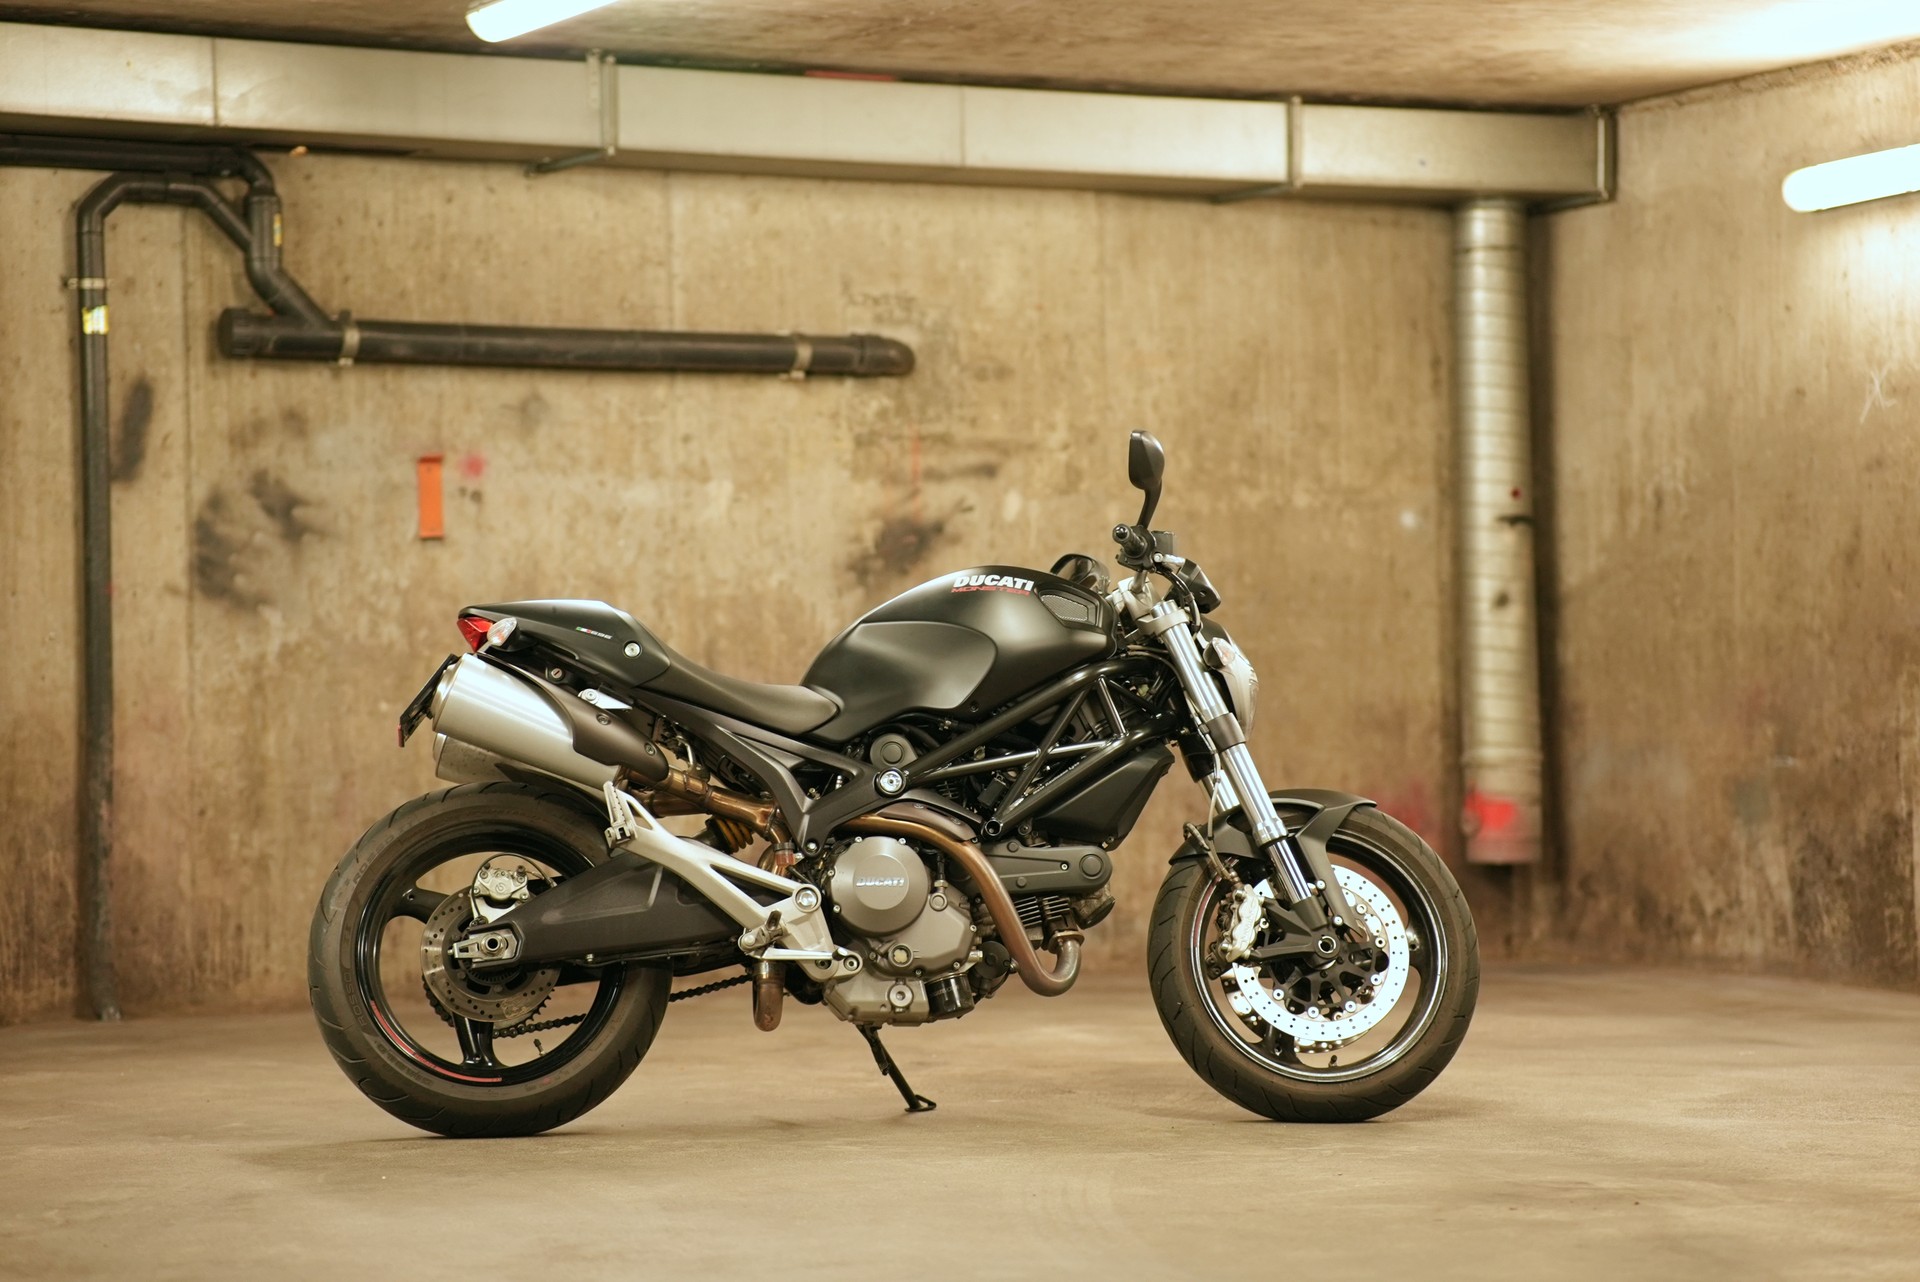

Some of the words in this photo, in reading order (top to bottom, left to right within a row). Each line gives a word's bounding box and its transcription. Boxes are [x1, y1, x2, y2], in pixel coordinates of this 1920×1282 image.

[951, 585, 1031, 597] MONSTER
[953, 574, 1034, 592] DUCATI
[343, 971, 367, 1027] ROSSO
